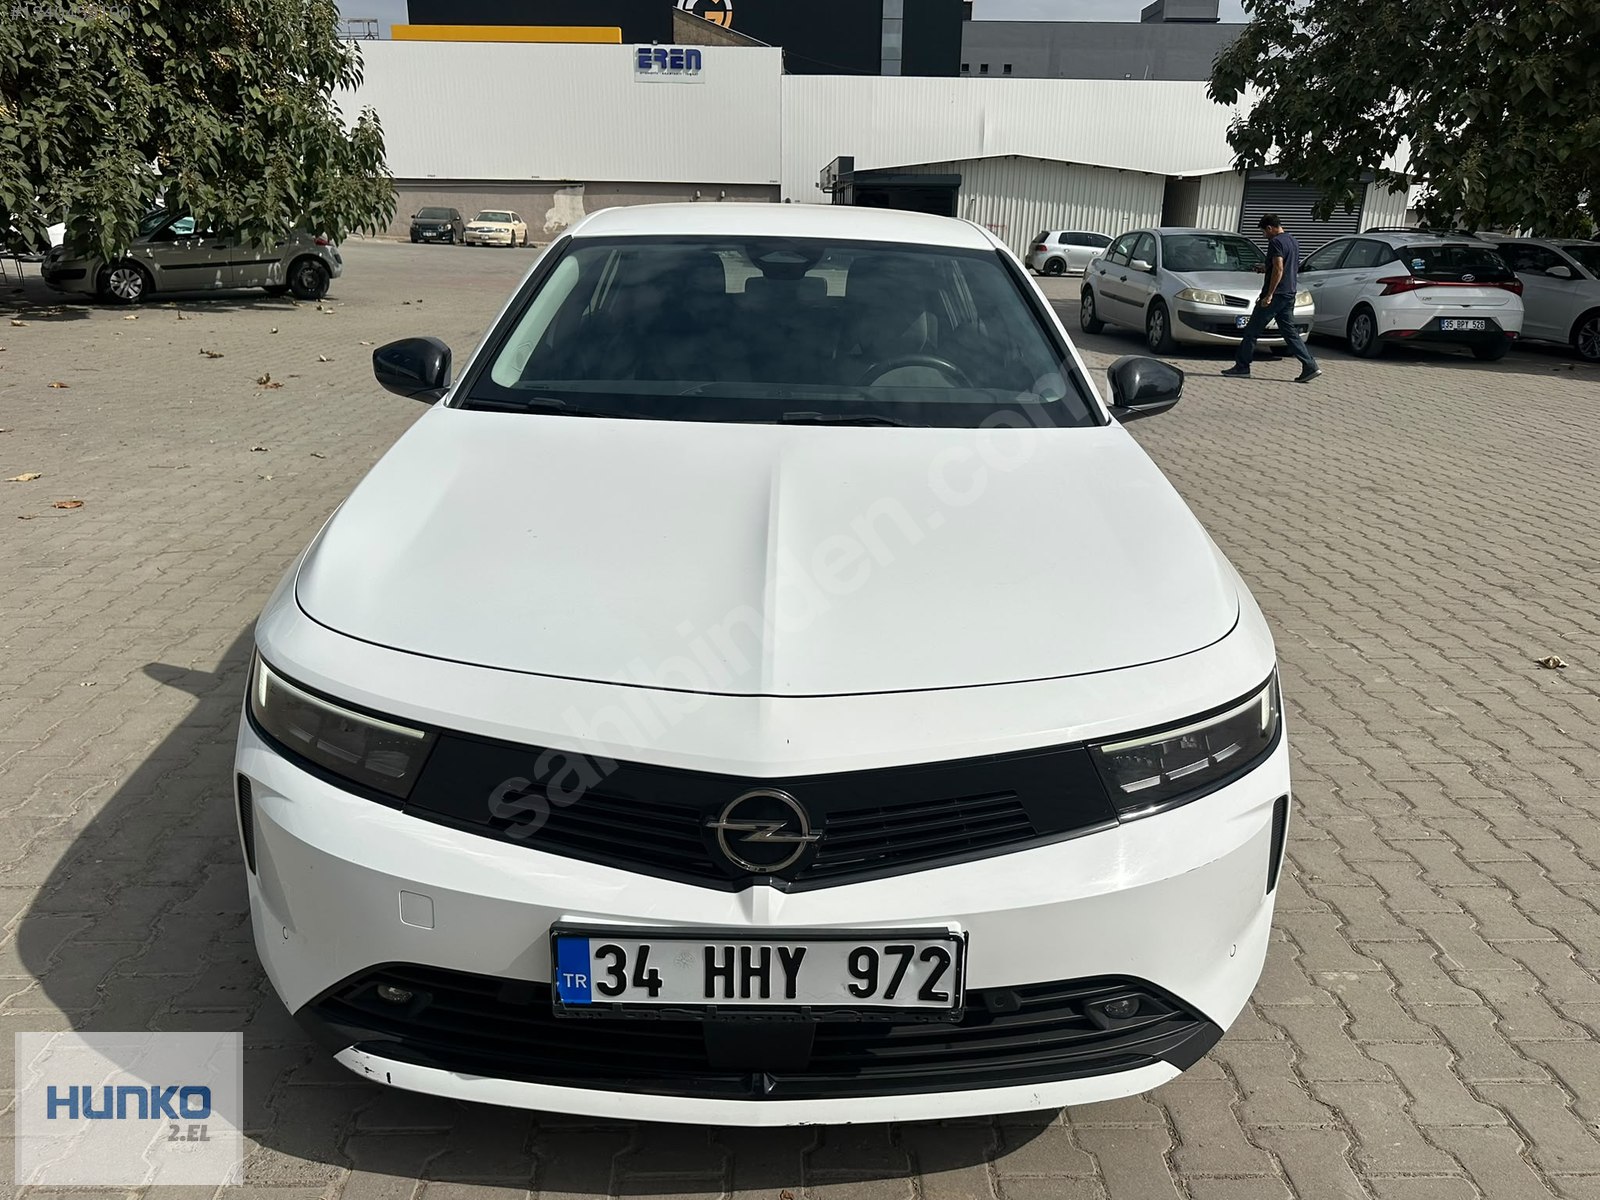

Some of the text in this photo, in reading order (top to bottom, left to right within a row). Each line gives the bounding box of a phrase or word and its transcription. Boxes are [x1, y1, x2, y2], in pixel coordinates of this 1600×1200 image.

[638, 48, 702, 70] EREN
[563, 944, 952, 1002] TR 34 HHY 972
